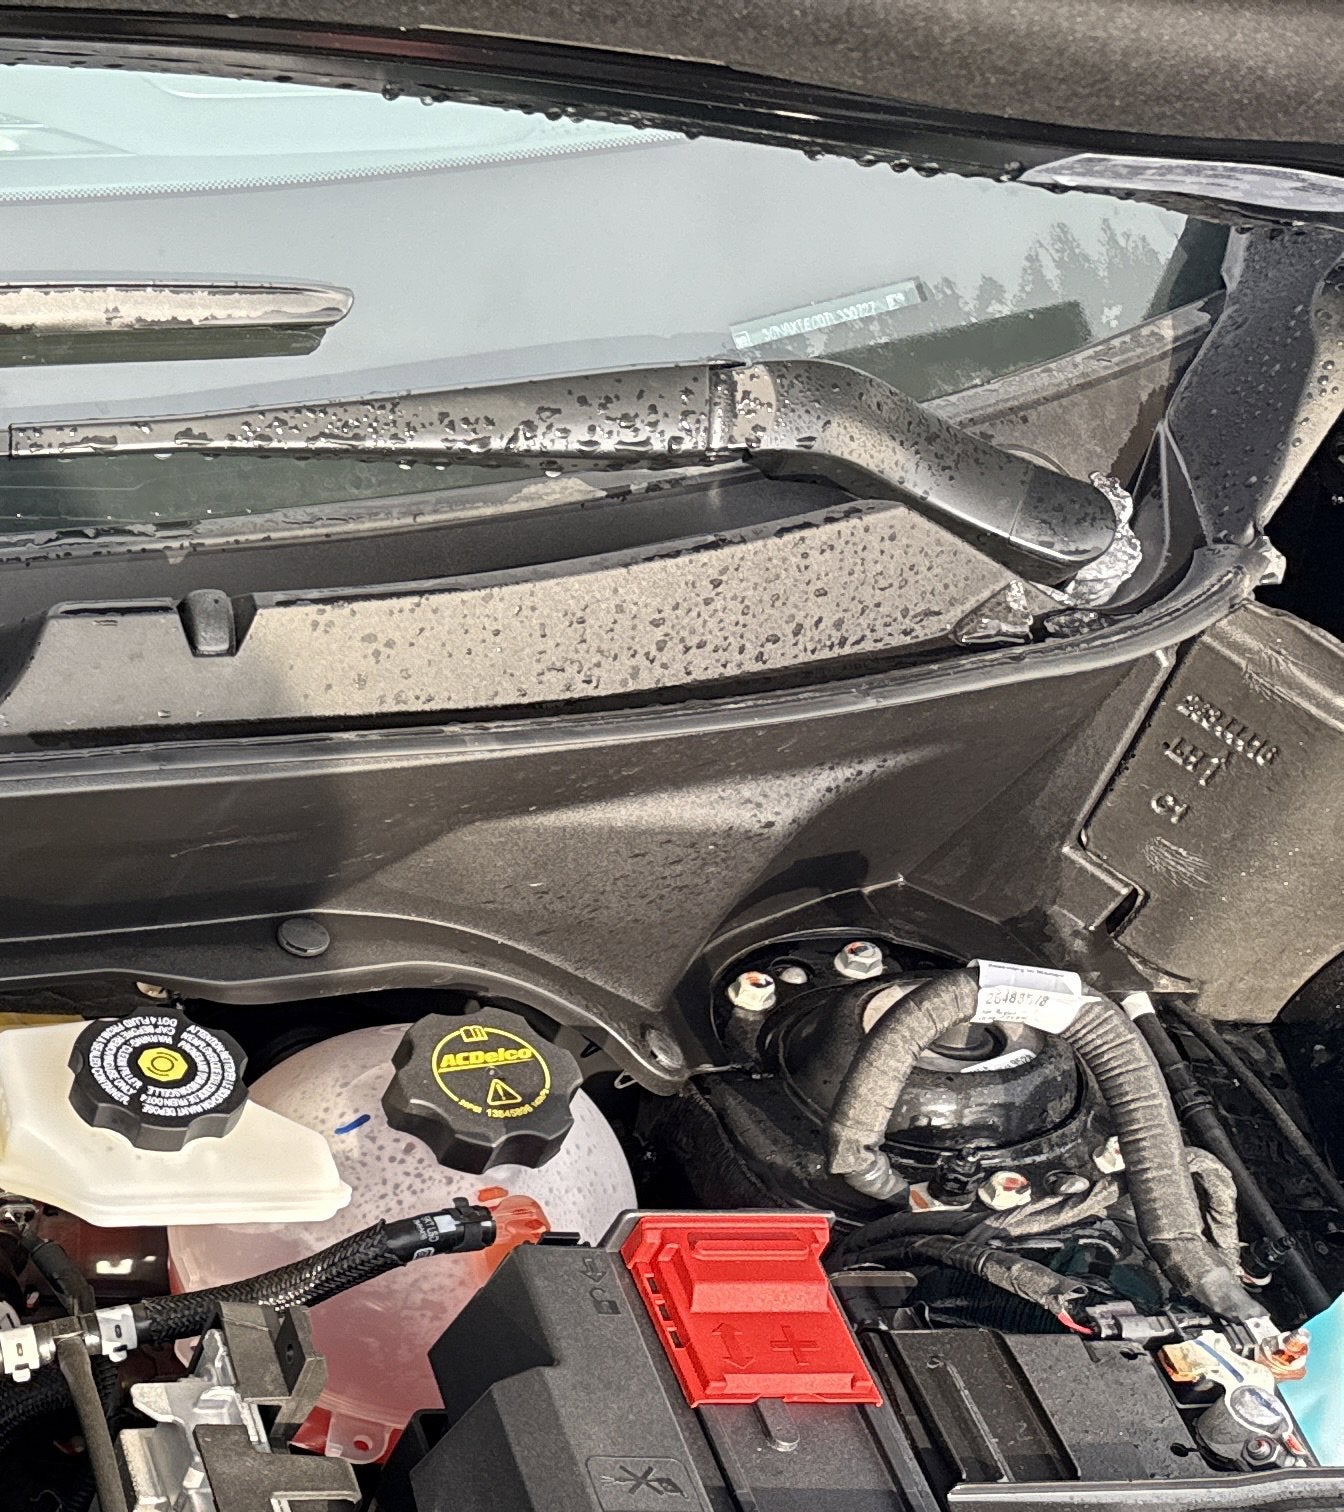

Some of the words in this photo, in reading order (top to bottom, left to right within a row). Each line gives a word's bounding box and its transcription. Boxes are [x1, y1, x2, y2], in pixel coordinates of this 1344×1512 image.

[123, 1016, 150, 1028] FLUID
[157, 1017, 178, 1027] DOT
[101, 1022, 125, 1041] FROM
[154, 1026, 176, 1036] CAP
[439, 1047, 533, 1068] ACDelco
[115, 1079, 138, 1095] ONLY
